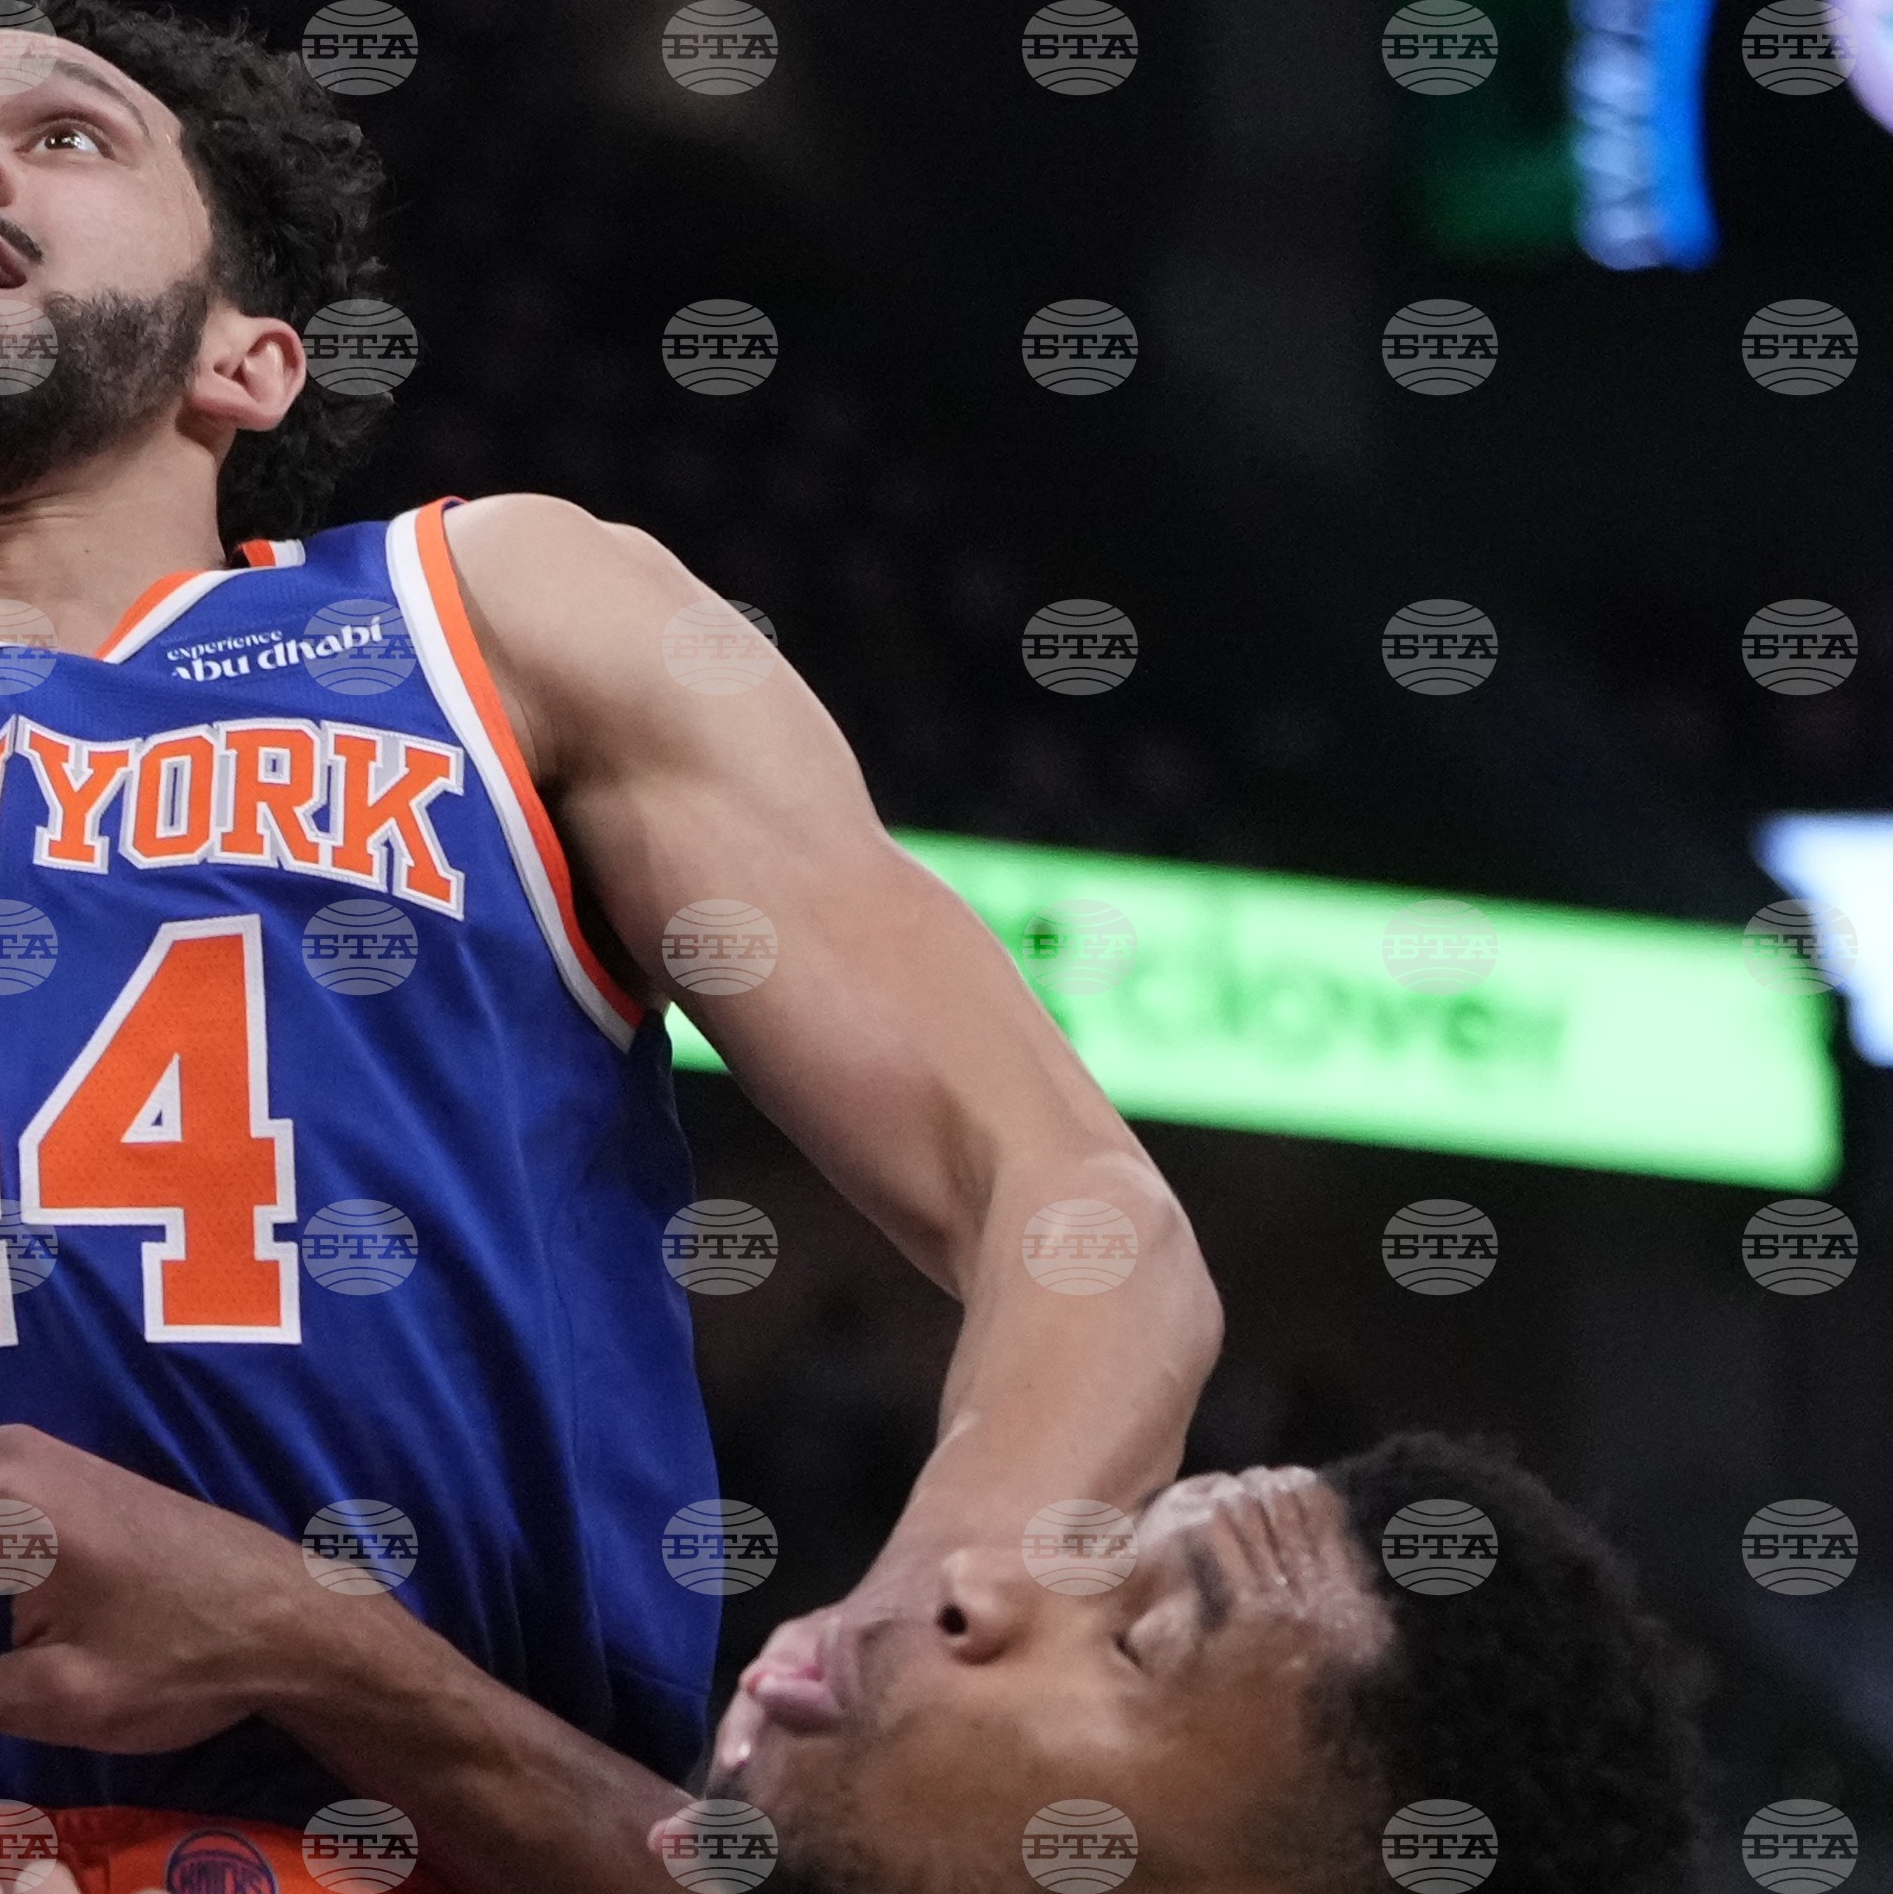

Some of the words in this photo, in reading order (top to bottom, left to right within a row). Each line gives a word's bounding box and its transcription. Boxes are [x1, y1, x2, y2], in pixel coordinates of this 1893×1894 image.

[166, 630, 283, 661] experience
[256, 615, 384, 670] dhabi
[16, 718, 466, 922] YORK
